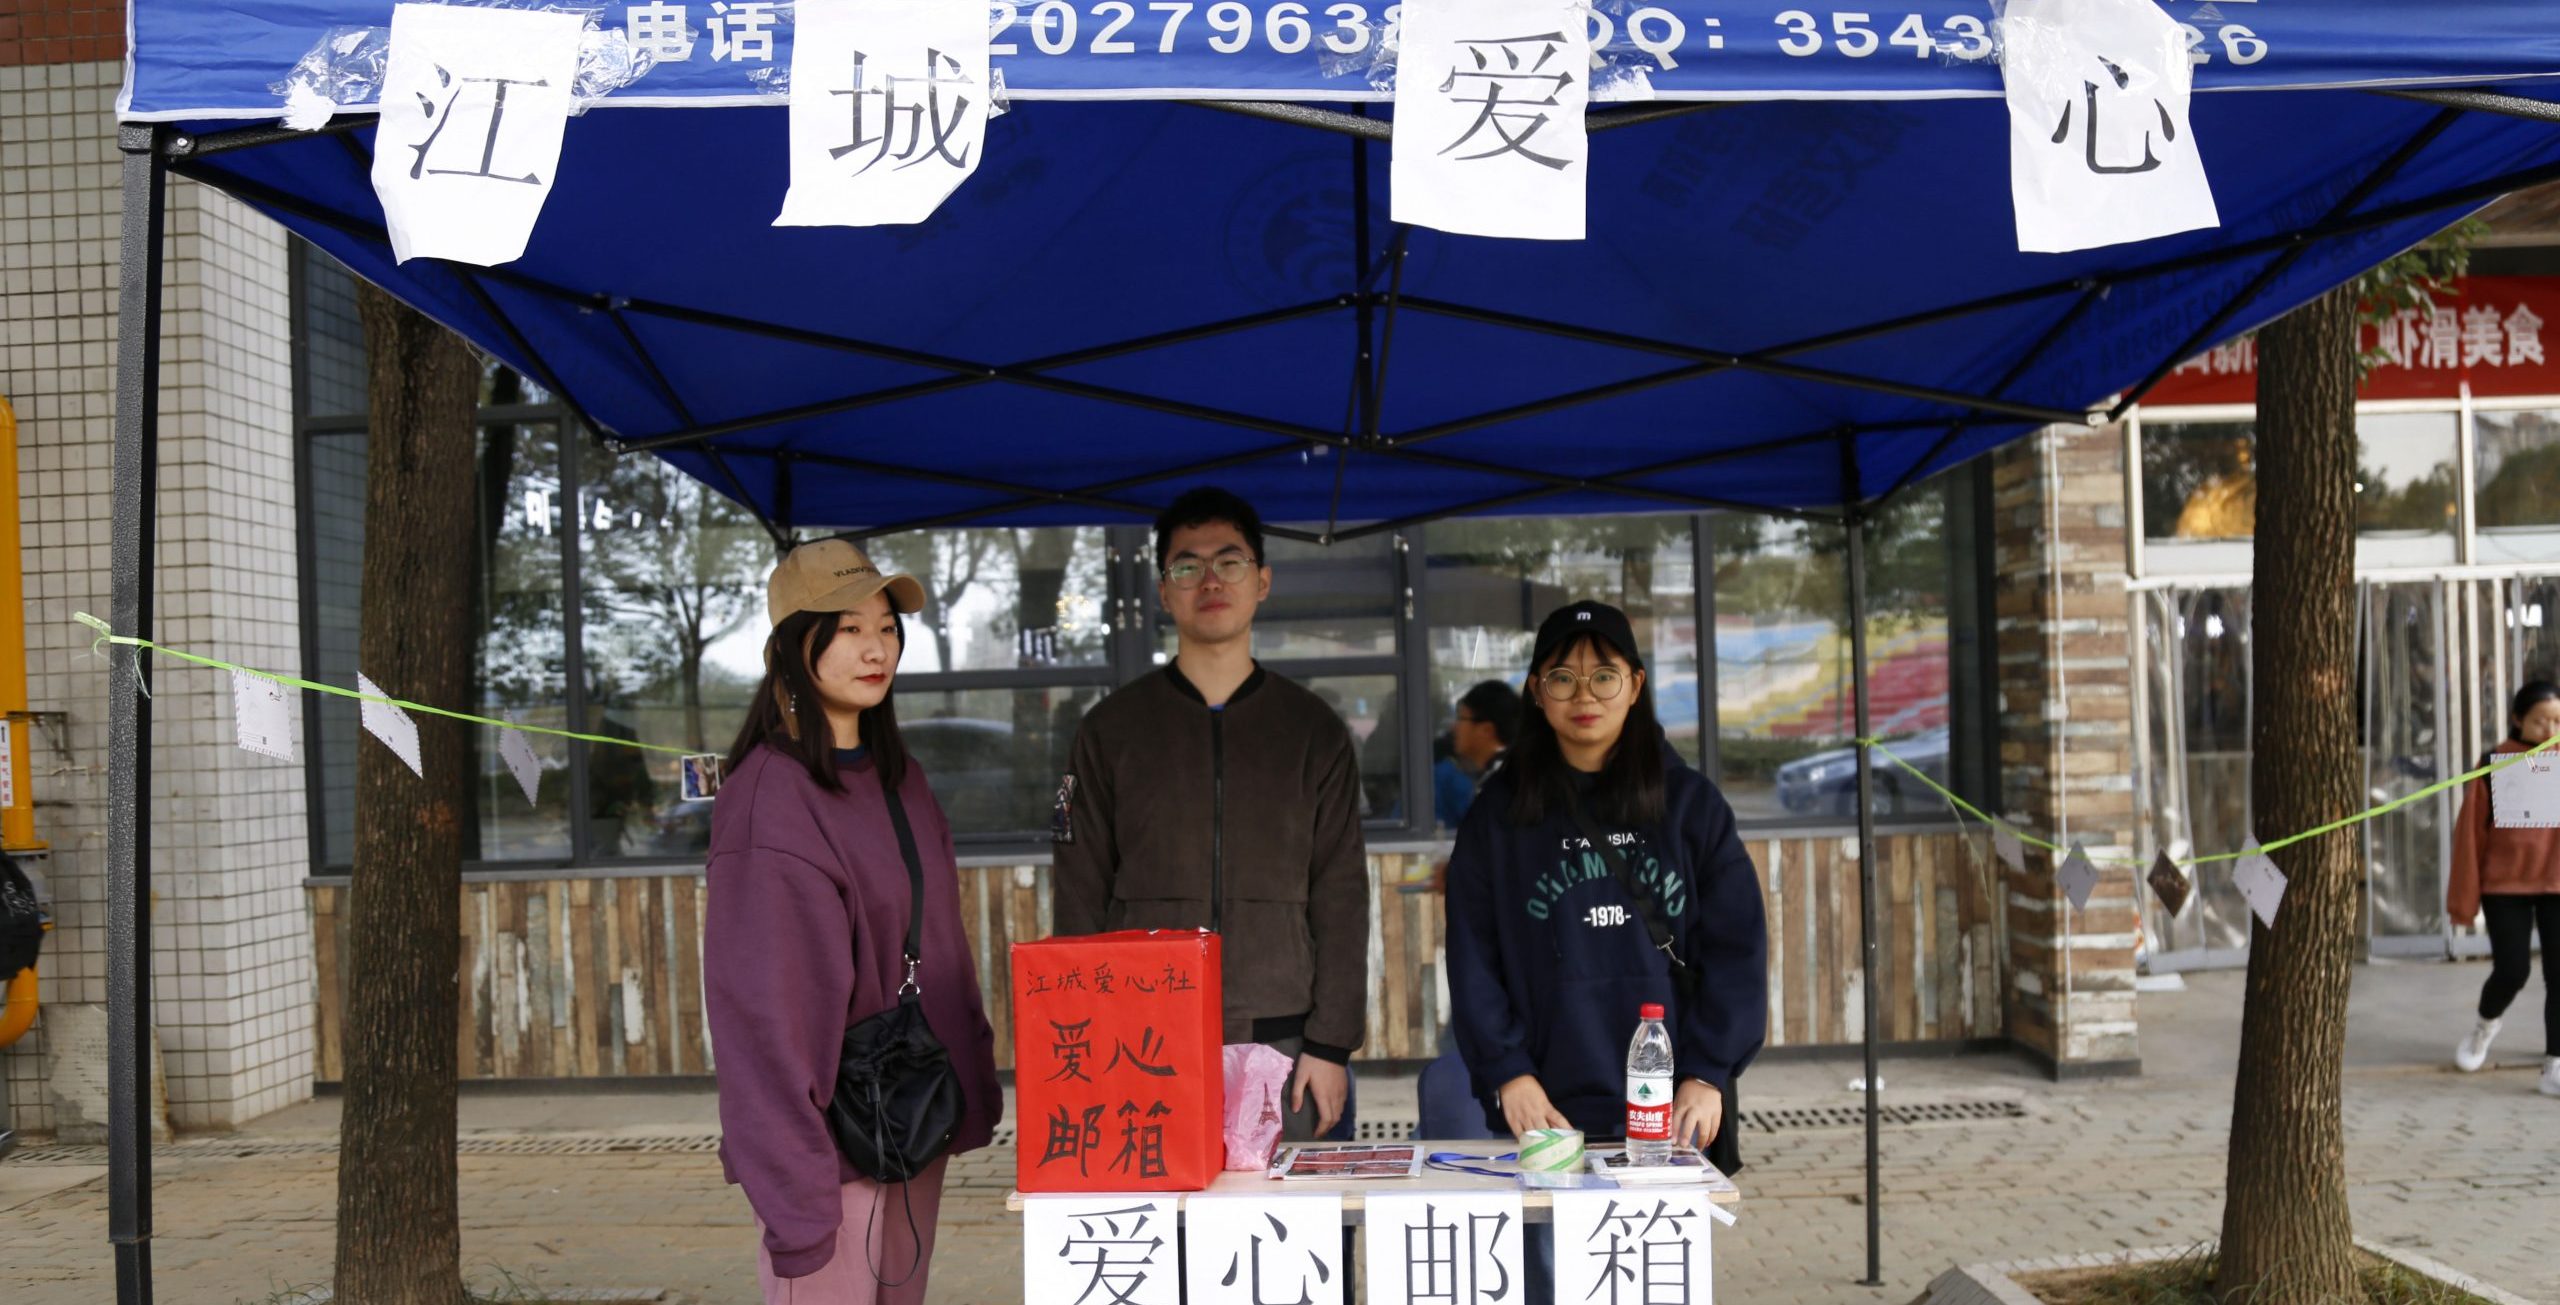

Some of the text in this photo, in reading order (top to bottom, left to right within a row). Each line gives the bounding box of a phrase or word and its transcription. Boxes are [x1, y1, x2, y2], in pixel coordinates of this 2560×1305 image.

[627, 1, 776, 62] 电话
[409, 63, 551, 186] 江
[829, 47, 976, 178] 城
[1437, 31, 1574, 171] 爱
[2052, 55, 2175, 174] 心
[1026, 962, 1196, 996] 江城爱心社
[1044, 1018, 1176, 1083] 爱心
[1037, 1099, 1172, 1179] 邮箱
[1058, 1199, 1697, 1305] 爱 心 邮 箱
